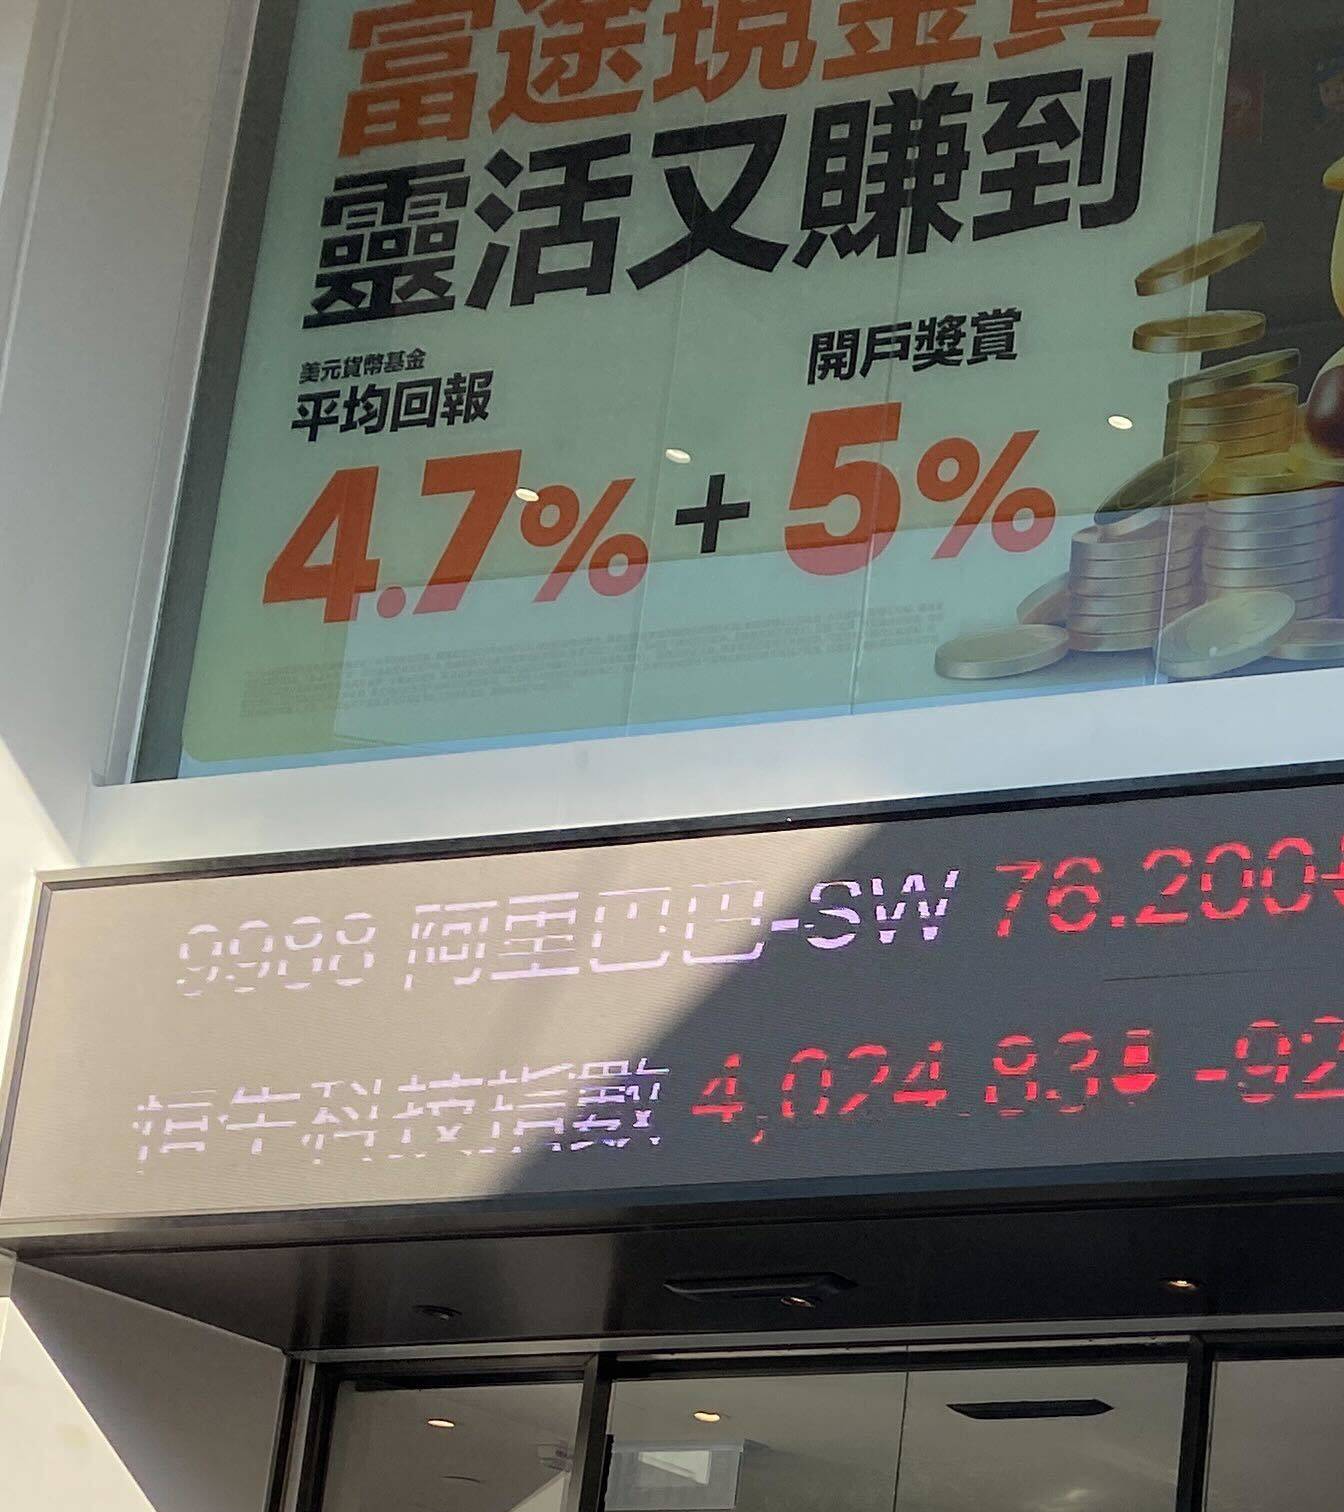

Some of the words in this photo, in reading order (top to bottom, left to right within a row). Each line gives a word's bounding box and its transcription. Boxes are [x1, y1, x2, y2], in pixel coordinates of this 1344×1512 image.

[303, 52, 1154, 330] 靈活又賺到
[299, 347, 426, 384] 美元貨幣基金
[808, 308, 1022, 384] 開戶獎賞
[291, 369, 494, 442] 平均回報
[262, 448, 649, 626] 4.7%
[674, 474, 750, 554] +
[784, 402, 1057, 577] 5%
[995, 837, 1316, 937] 76.200
